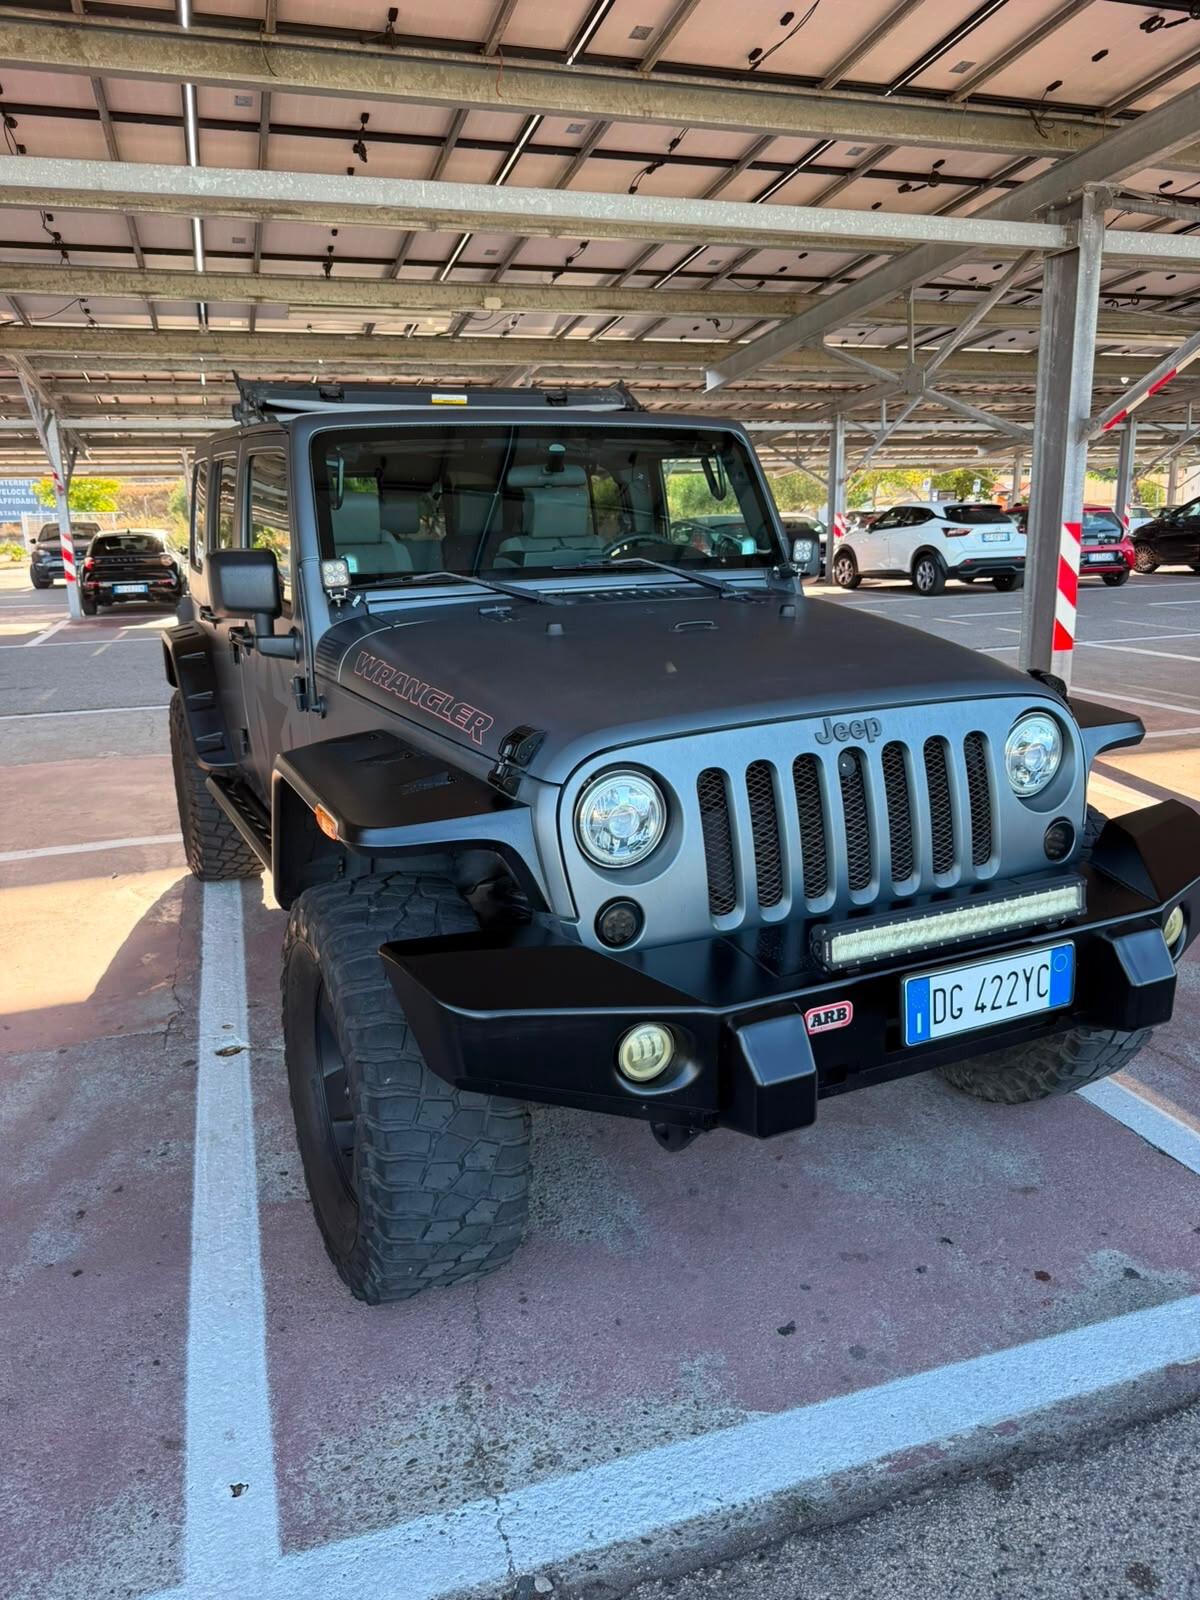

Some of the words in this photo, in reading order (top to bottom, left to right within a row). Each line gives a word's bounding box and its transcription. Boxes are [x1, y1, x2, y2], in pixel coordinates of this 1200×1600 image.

[354, 651, 495, 746] WRANGLER
[814, 717, 882, 745] Jeep
[933, 984, 963, 1025] DG
[974, 964, 1050, 1013] 422YC
[810, 1007, 848, 1029] ARB
